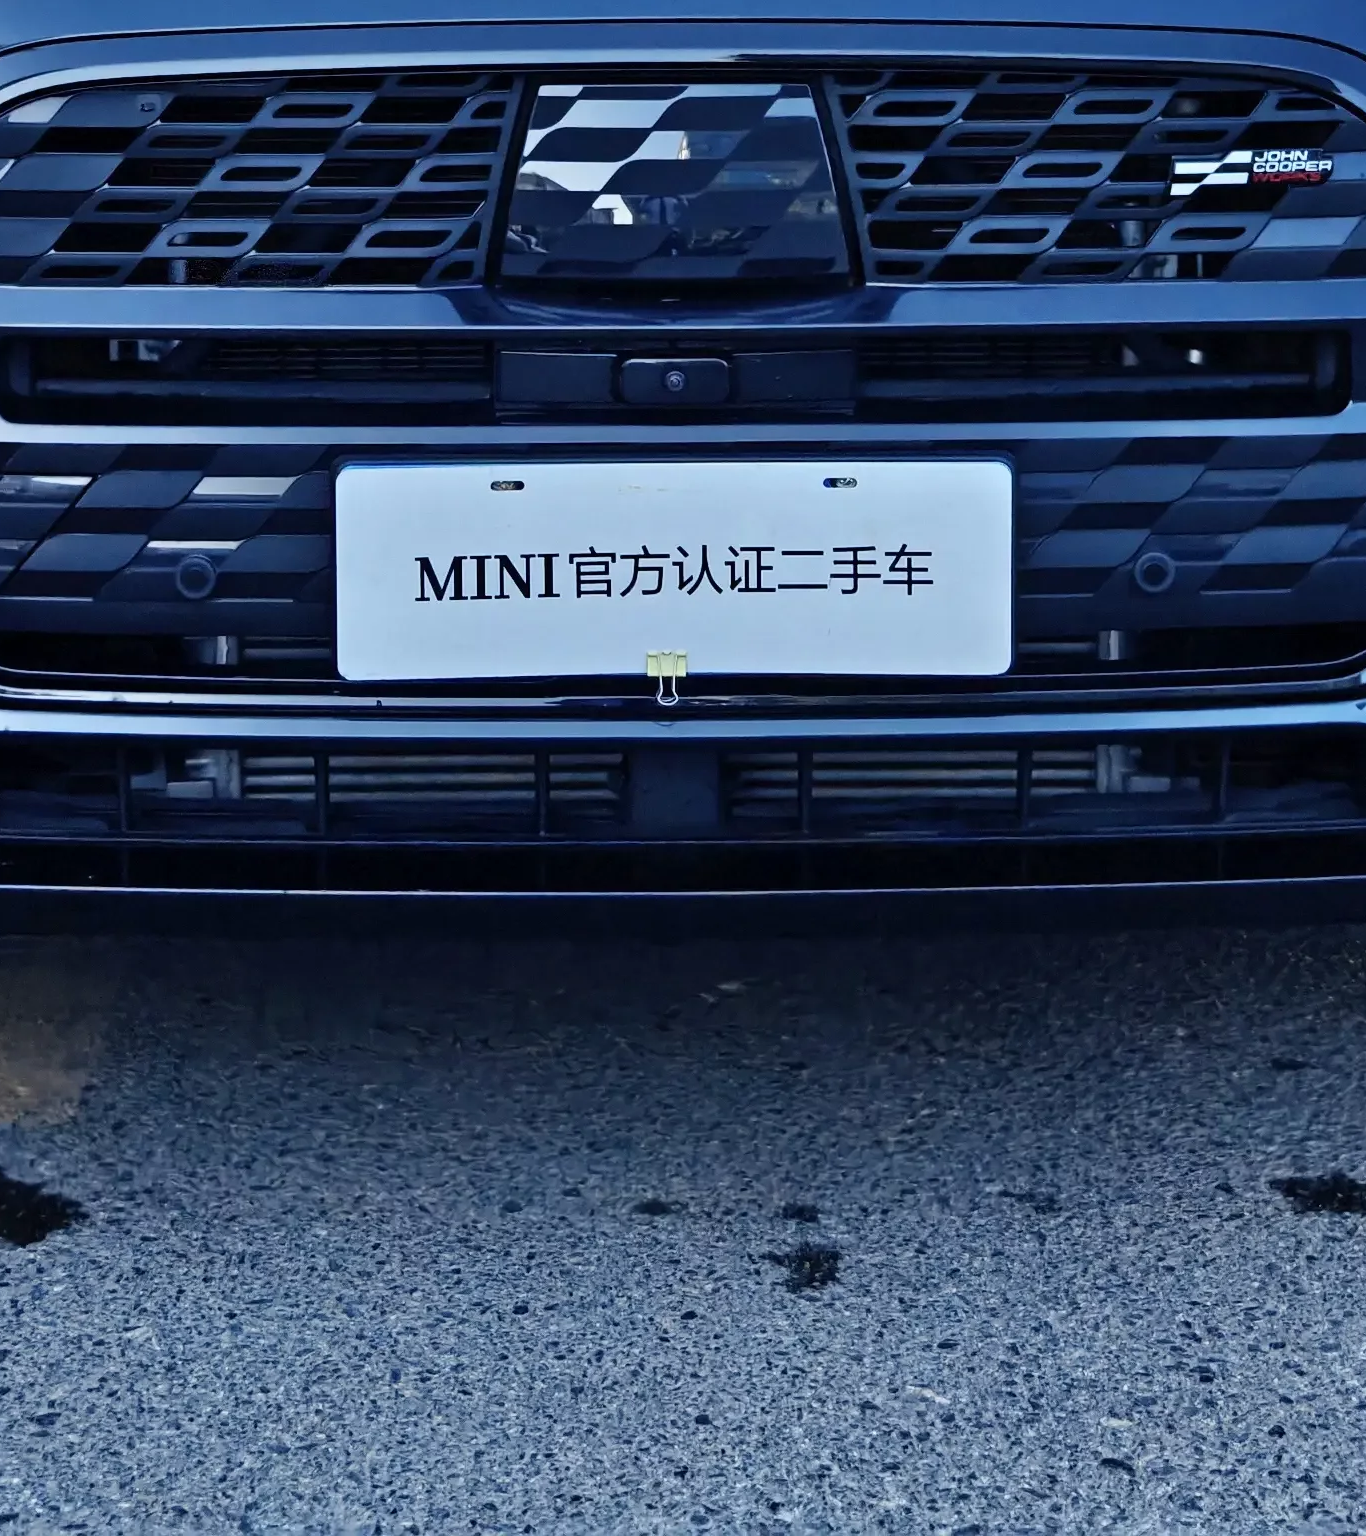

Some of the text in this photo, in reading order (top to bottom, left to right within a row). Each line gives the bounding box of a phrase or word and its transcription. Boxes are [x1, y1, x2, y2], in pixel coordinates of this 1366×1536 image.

[1254, 150, 1308, 162] JOHN
[1252, 160, 1333, 173] COOPER
[414, 543, 934, 602] MINI官方认证二手车
